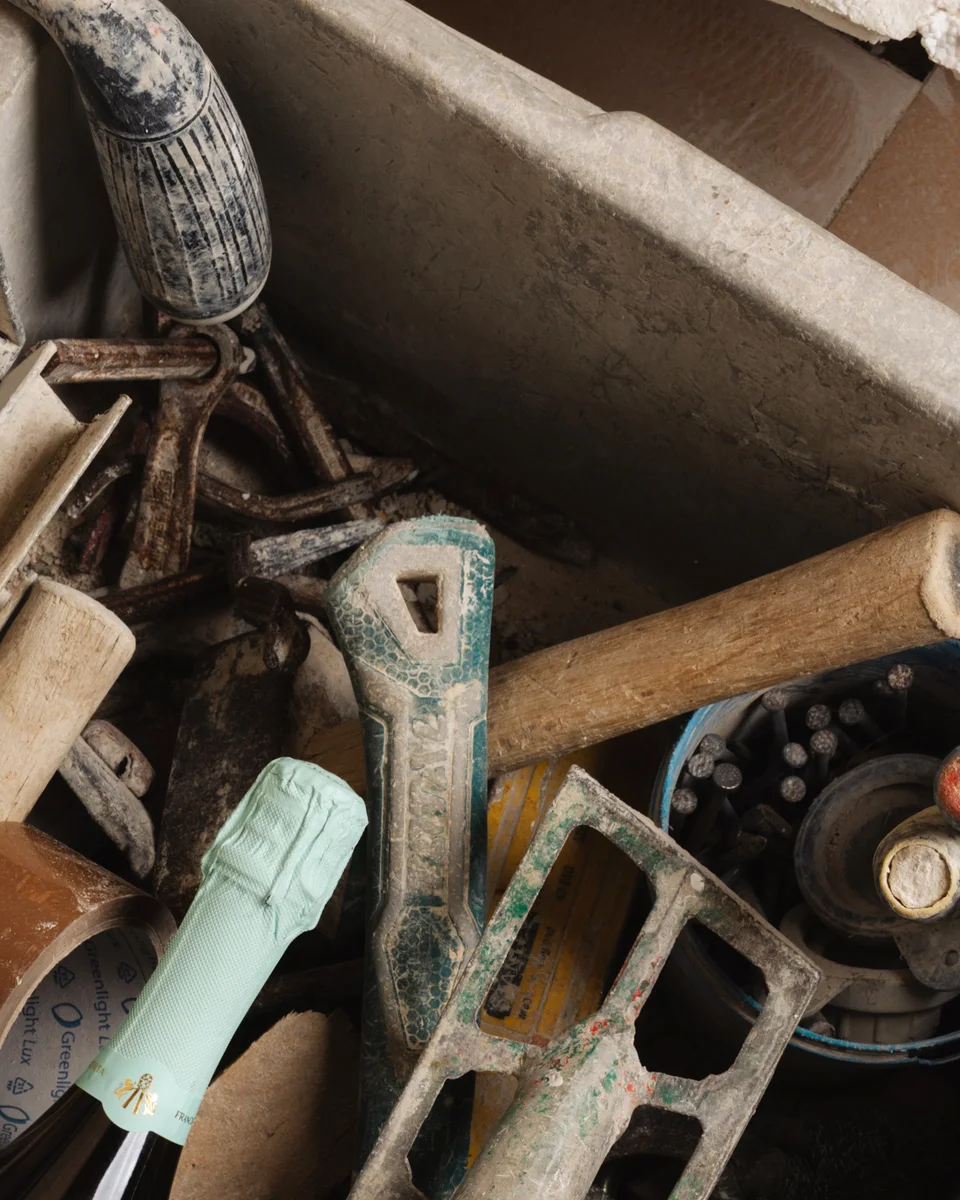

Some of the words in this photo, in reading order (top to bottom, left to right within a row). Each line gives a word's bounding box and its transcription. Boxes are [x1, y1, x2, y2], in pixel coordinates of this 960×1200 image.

[85, 940, 111, 1031] Greenlight
[21, 995, 40, 1035] light
[20, 1039, 37, 1066] Lux
[50, 1031, 76, 1102] Greenlig
